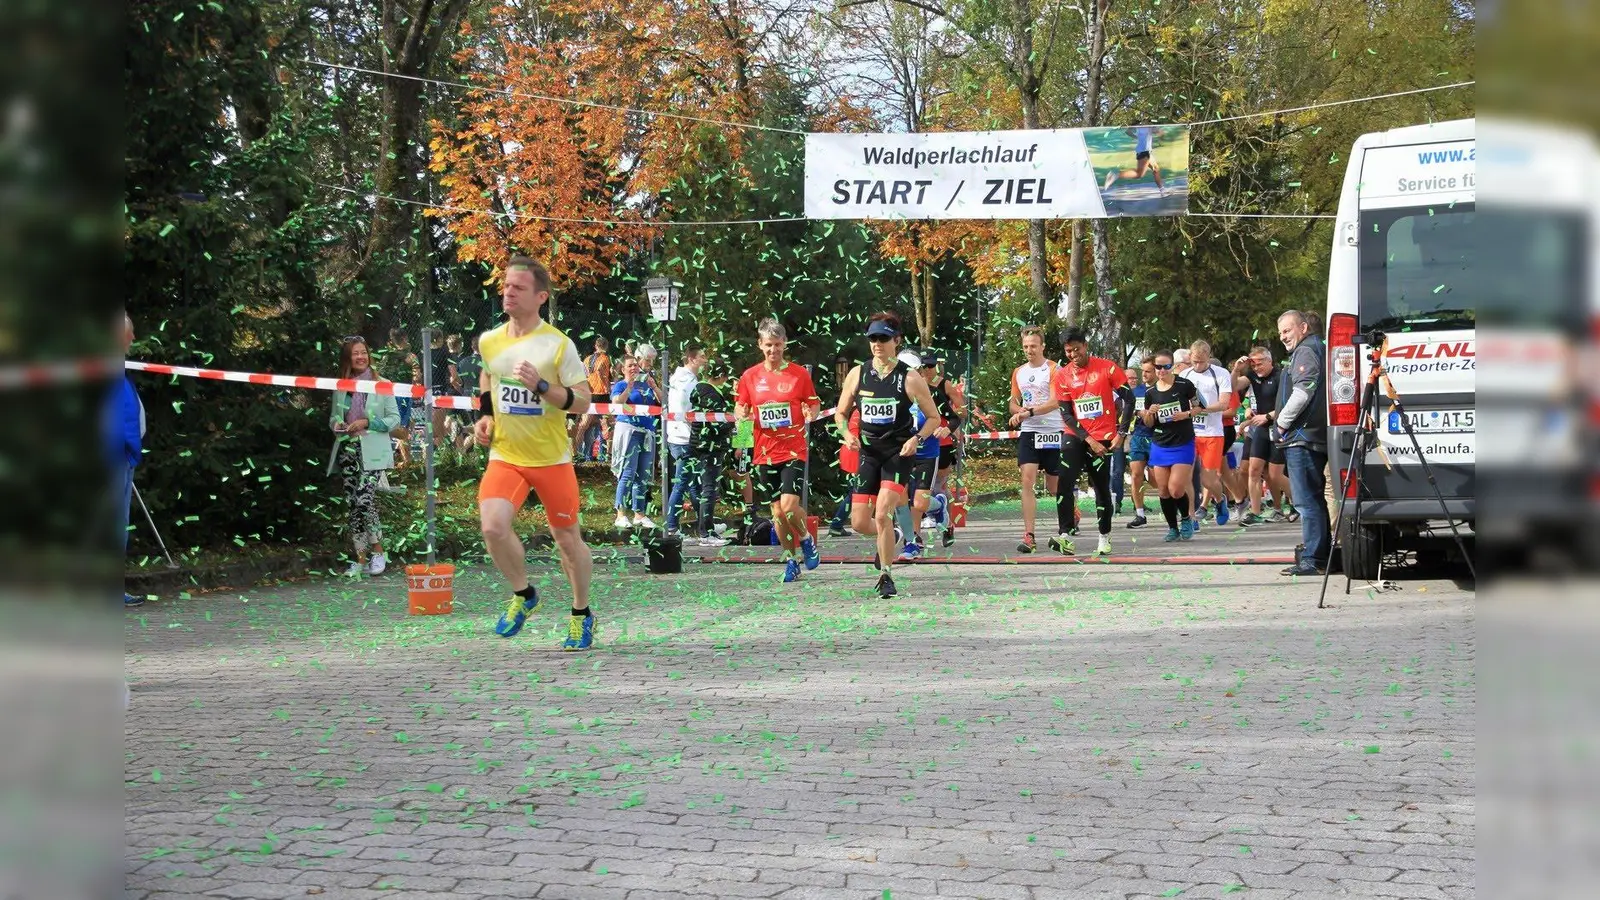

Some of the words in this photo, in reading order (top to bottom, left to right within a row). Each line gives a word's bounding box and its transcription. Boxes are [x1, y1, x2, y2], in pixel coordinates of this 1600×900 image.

[863, 143, 1037, 169] Waldperlachlauf
[1398, 176, 1457, 192] Service
[832, 179, 932, 205] START
[945, 180, 964, 211] /
[983, 178, 1053, 205] ZIEL
[502, 387, 541, 405] 2014
[864, 405, 893, 416] 2048
[1078, 401, 1100, 413] 1087
[1037, 434, 1060, 443] 2000
